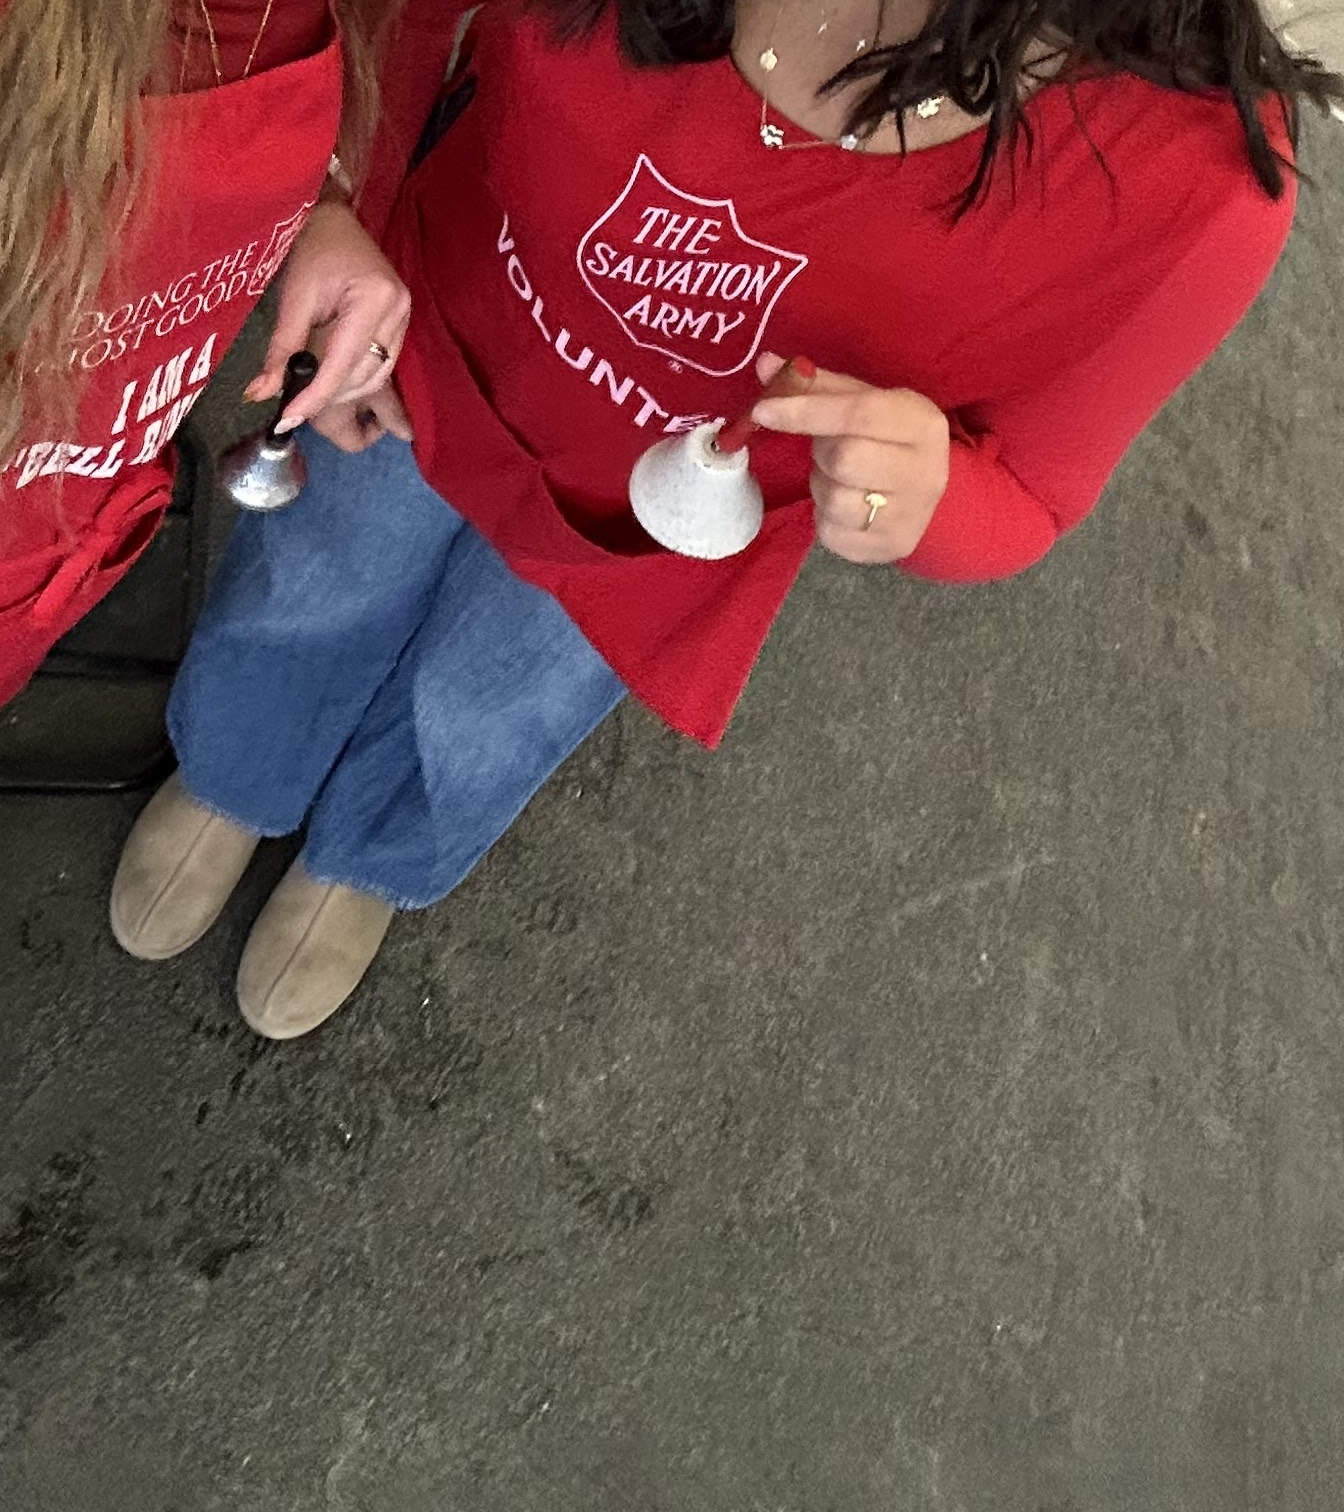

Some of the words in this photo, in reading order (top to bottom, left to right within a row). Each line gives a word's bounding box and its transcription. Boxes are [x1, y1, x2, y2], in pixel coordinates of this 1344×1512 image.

[631, 205, 723, 255] THE
[71, 272, 198, 339] DOING
[201, 240, 259, 289] THE
[155, 270, 248, 338] GOOD
[585, 241, 782, 305] SALVATION
[496, 209, 709, 434] VOLUNTE
[622, 293, 746, 345] ARMY
[111, 380, 138, 436] I
[136, 346, 194, 423] AM
[187, 332, 218, 385] A
